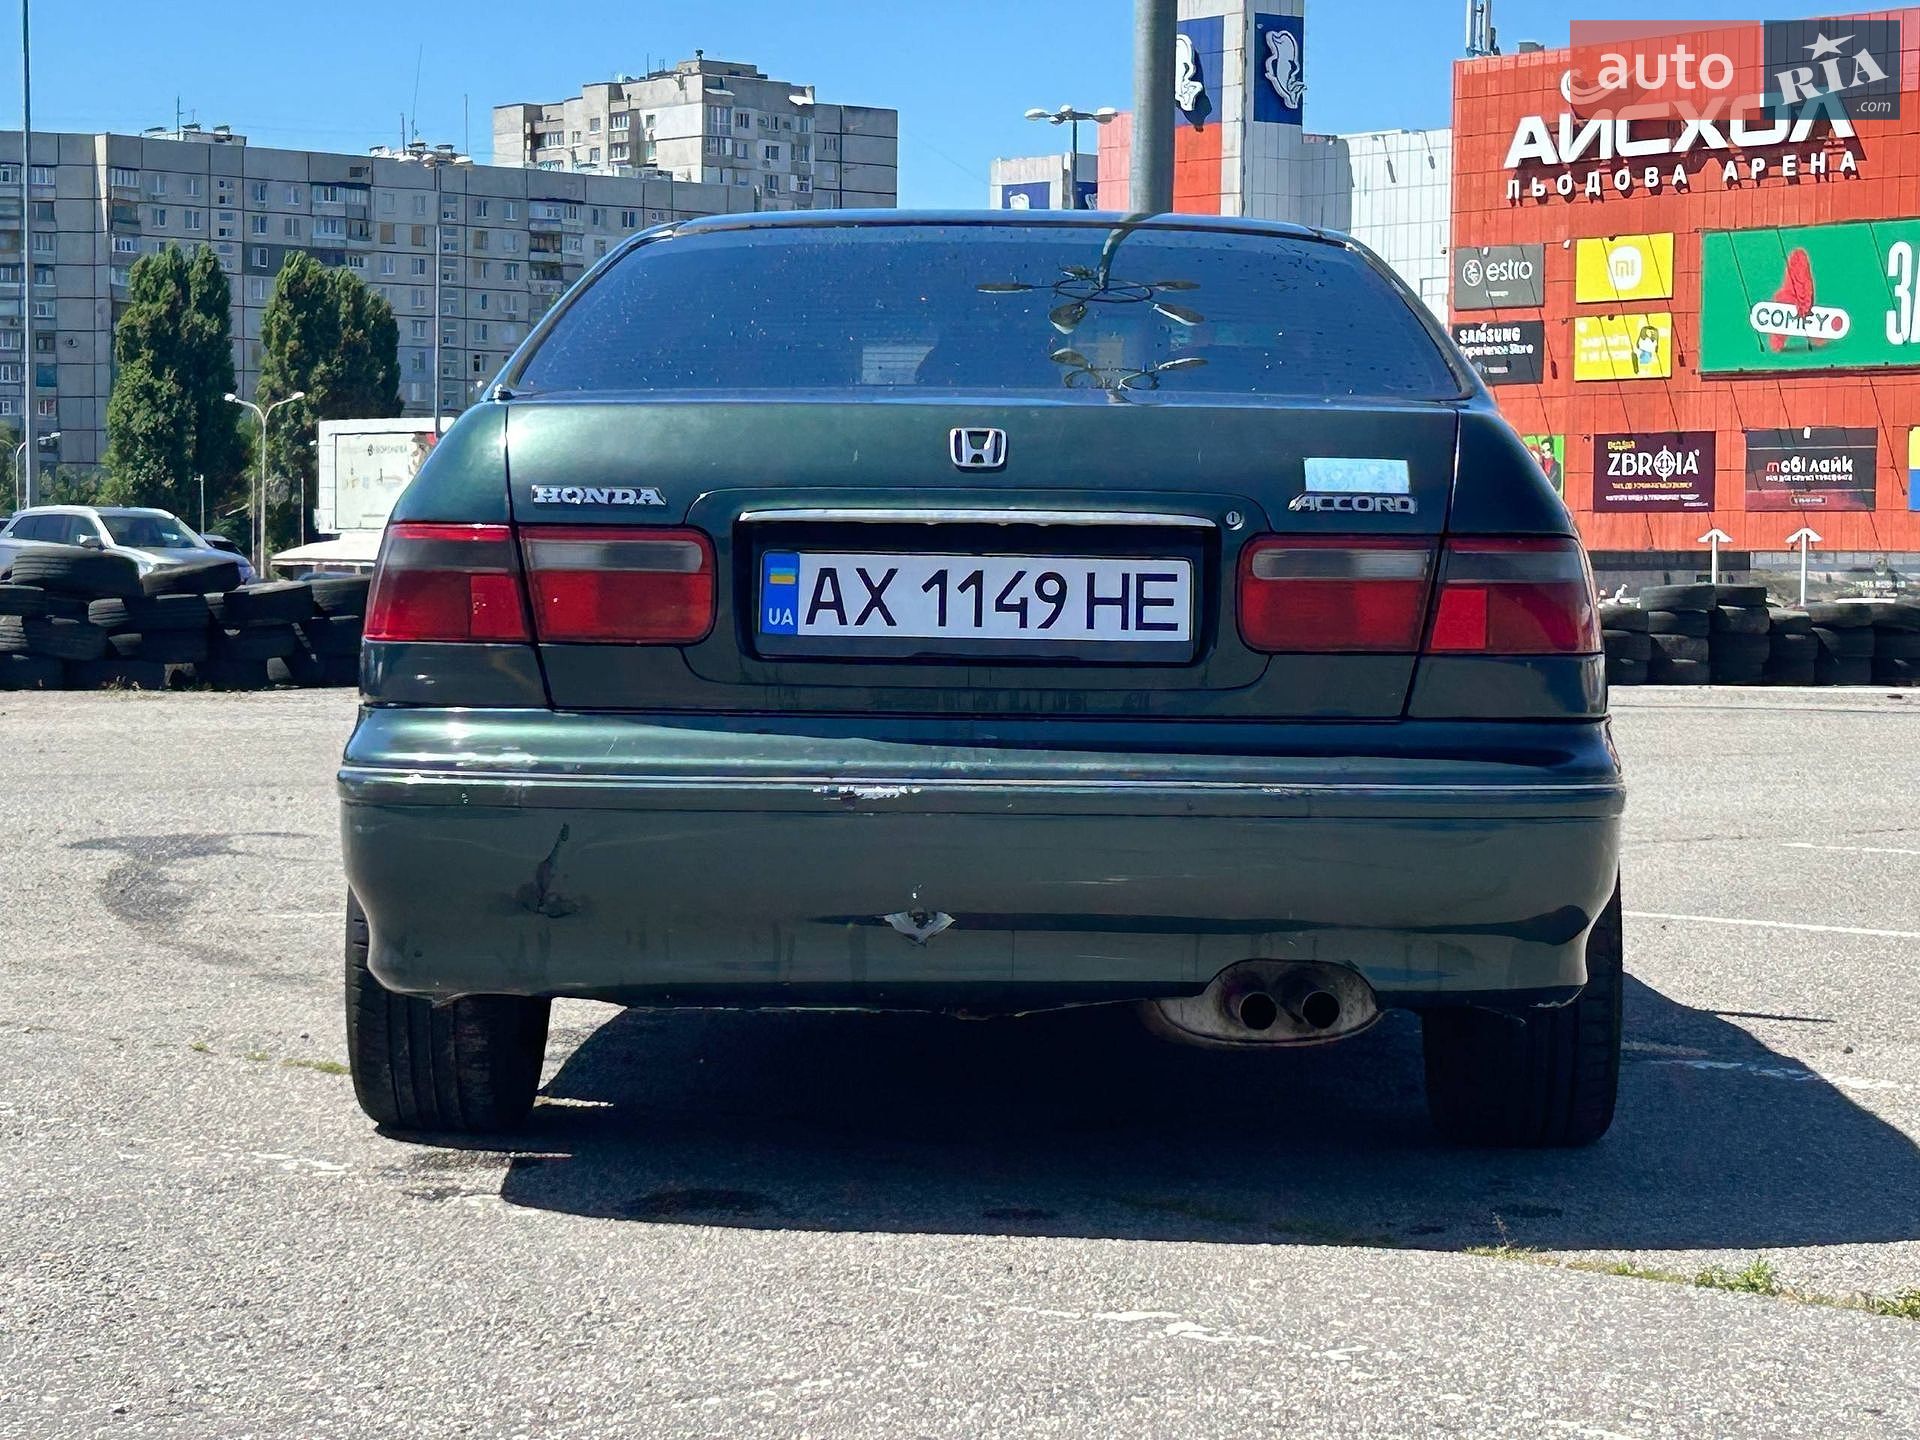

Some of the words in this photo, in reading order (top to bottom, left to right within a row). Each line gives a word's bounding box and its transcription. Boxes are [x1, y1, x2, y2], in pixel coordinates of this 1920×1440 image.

[1506, 163, 1688, 200] ЛЬОДОВА
[1722, 150, 1857, 182] АРЕНА
[1485, 259, 1533, 281] estro
[1756, 307, 1829, 332] COMFY
[1459, 327, 1521, 345] SAMSUNG
[1606, 445, 1699, 481] ZBROIA
[533, 486, 665, 505] HONDA
[1288, 494, 1418, 514] ACCORD
[804, 567, 899, 627] AX
[921, 568, 1068, 630] 1149
[1086, 571, 1180, 632] HE
[768, 607, 795, 626] UA
